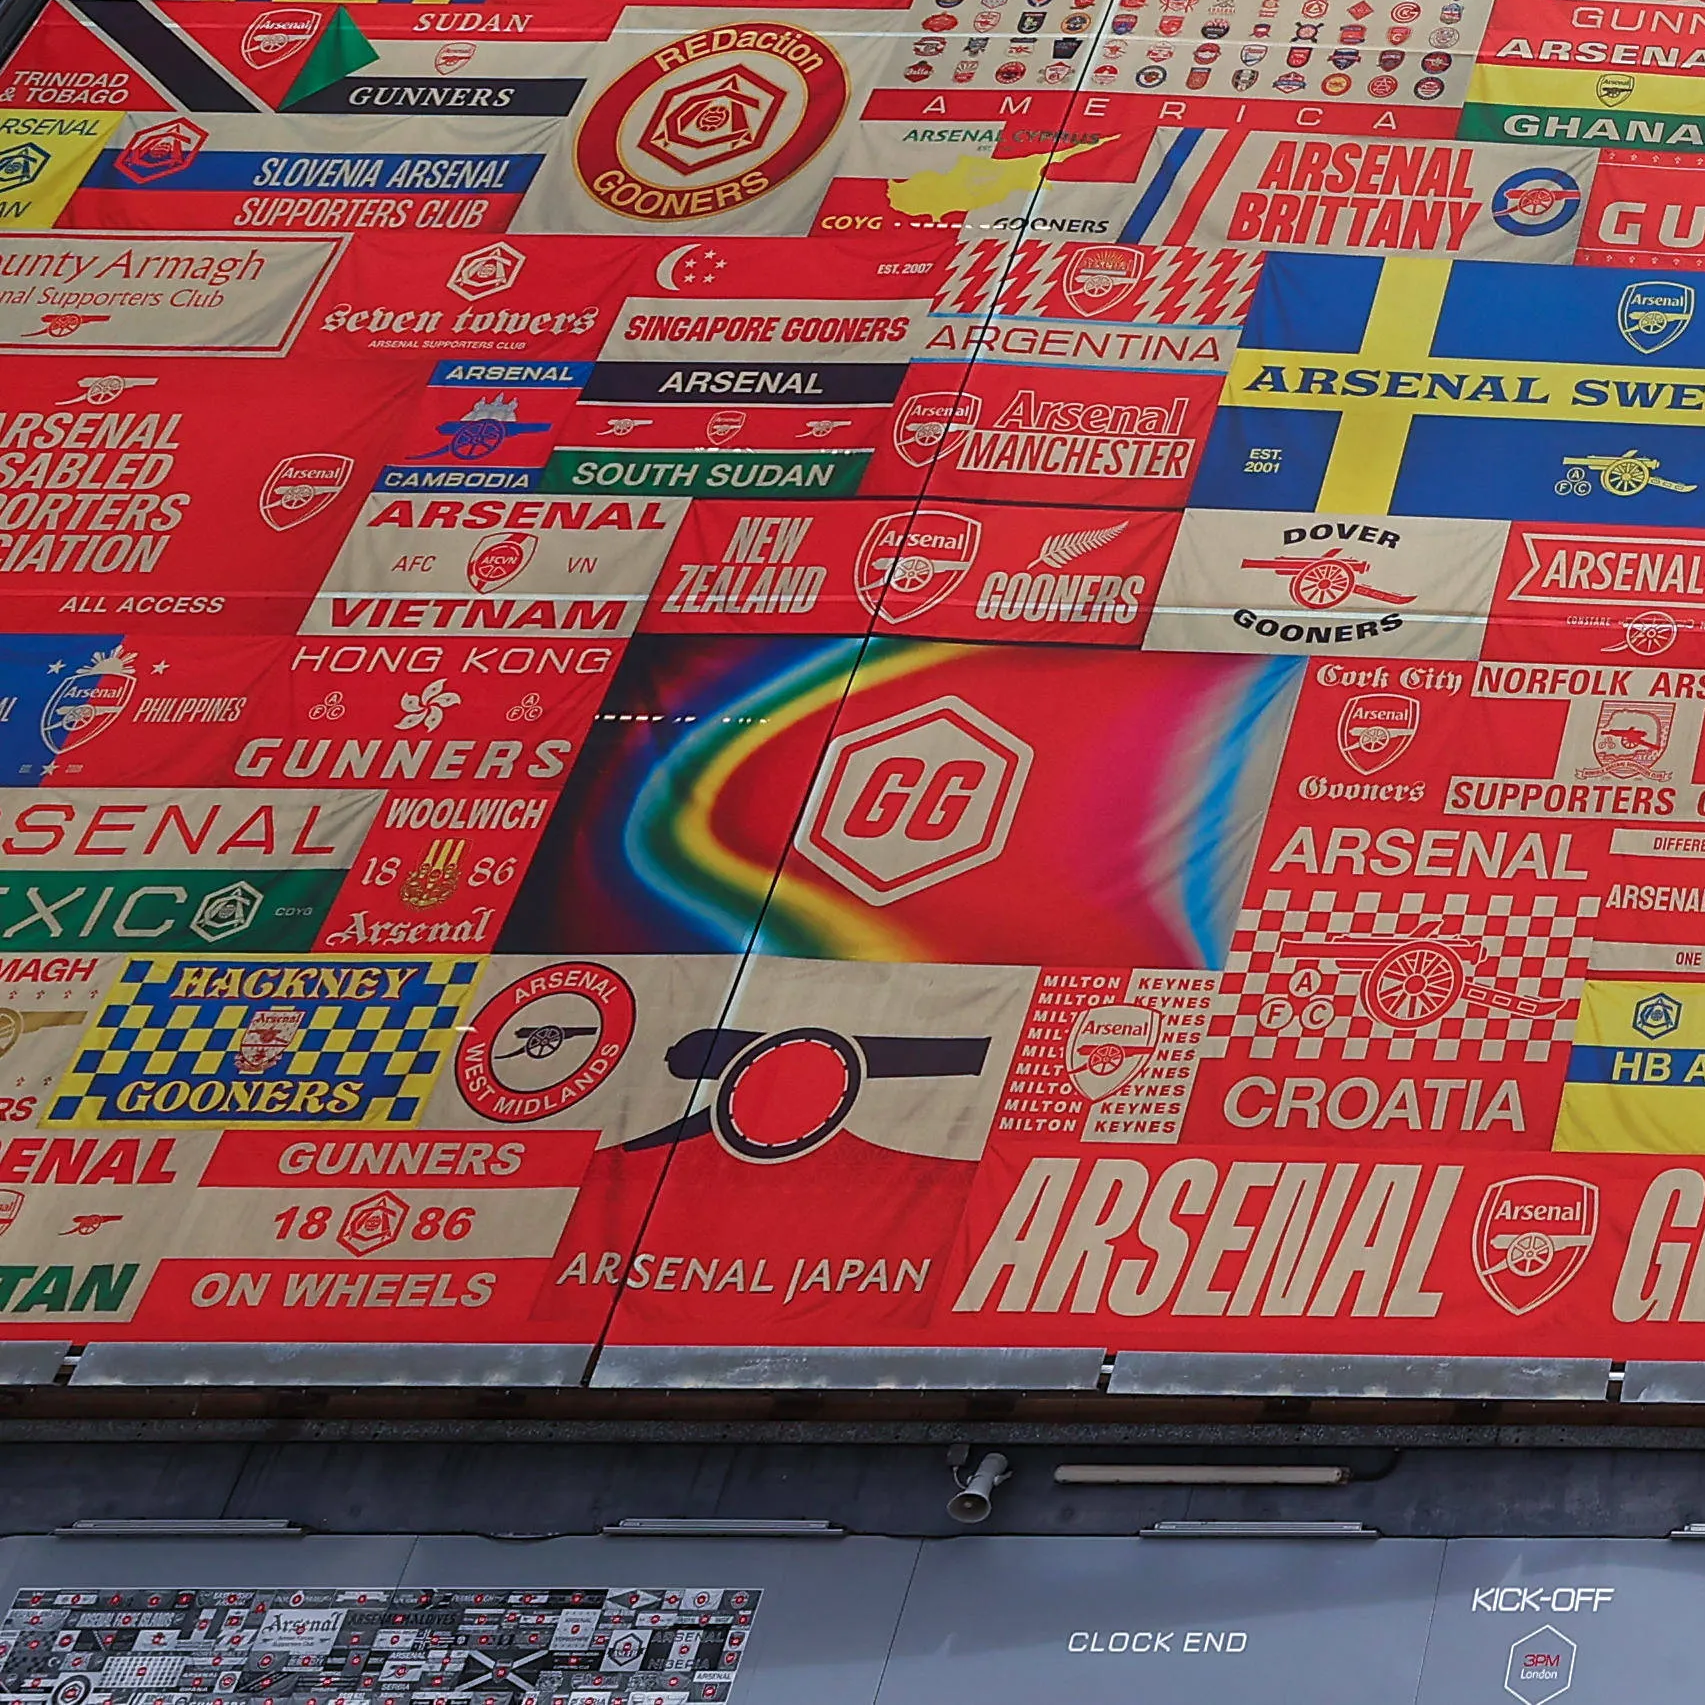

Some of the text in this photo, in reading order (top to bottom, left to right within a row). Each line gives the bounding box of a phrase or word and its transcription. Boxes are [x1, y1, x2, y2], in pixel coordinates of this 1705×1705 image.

[412, 13, 533, 32] SUDAN
[12, 71, 130, 88] TRINIDAD
[1503, 113, 1705, 147] GHANA
[253, 158, 505, 188] SLOVENIA ARSENAL
[234, 198, 488, 229] SUPPORTERS CLUB
[820, 215, 882, 231] COYG
[877, 262, 934, 275] EST. 2007
[623, 316, 910, 343] SINGAPORE GOONERS
[368, 340, 526, 350] ARSENAL SUPPORTERS CLUB
[925, 325, 1221, 362] ARGENTINA
[446, 364, 574, 382] ARSENAL
[1240, 364, 1551, 406] ARSENAL
[957, 435, 1191, 479] MANCHESTER
[384, 473, 530, 490] CAMBODIA
[724, 518, 814, 564] NEW
[662, 566, 828, 614] ZEALAND
[59, 597, 225, 614] ALL ACCESS
[330, 599, 631, 630] VIETNAM
[291, 647, 611, 674] HONG KONG
[1477, 667, 1630, 697] NORFOLK
[133, 697, 247, 723] PHILIPPINES
[384, 799, 547, 830] WOOLWICH
[170, 967, 420, 1001] HACKNEY
[1223, 1077, 1525, 1132] CROATIA
[998, 1117, 1177, 1134] MILTON KEYNES
[951, 1157, 1464, 1318] ARSENAL
[557, 1251, 932, 1305] ARSENAL JAPAN
[1471, 1588, 1615, 1612] KICK-OFF
[1068, 1632, 1248, 1653] CLOCK END
[1520, 1667, 1558, 1680] London
[1522, 1653, 1560, 1668] 3PM
